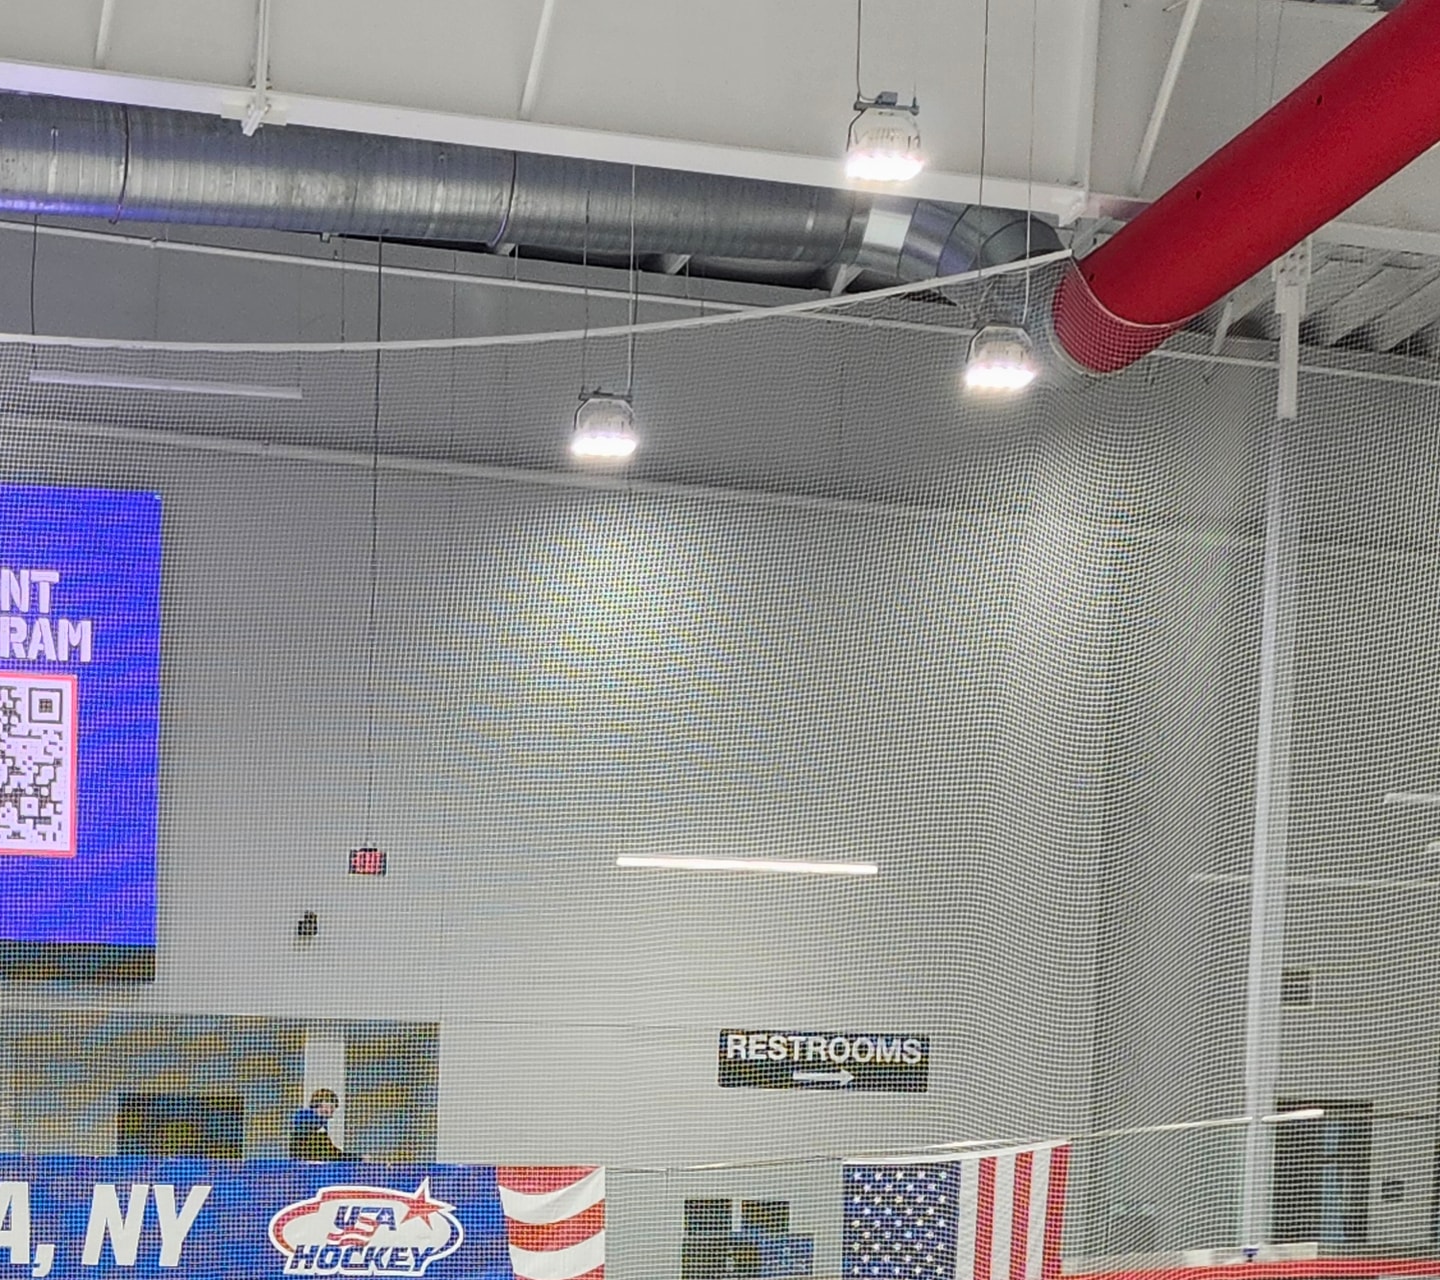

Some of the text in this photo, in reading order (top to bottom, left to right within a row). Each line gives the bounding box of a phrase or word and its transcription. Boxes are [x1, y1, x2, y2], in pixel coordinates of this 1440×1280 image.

[726, 1034, 923, 1065] RESTROOMS
[82, 1183, 212, 1267] NY
[334, 1204, 397, 1233] USA
[289, 1243, 435, 1273] HOCKEY
